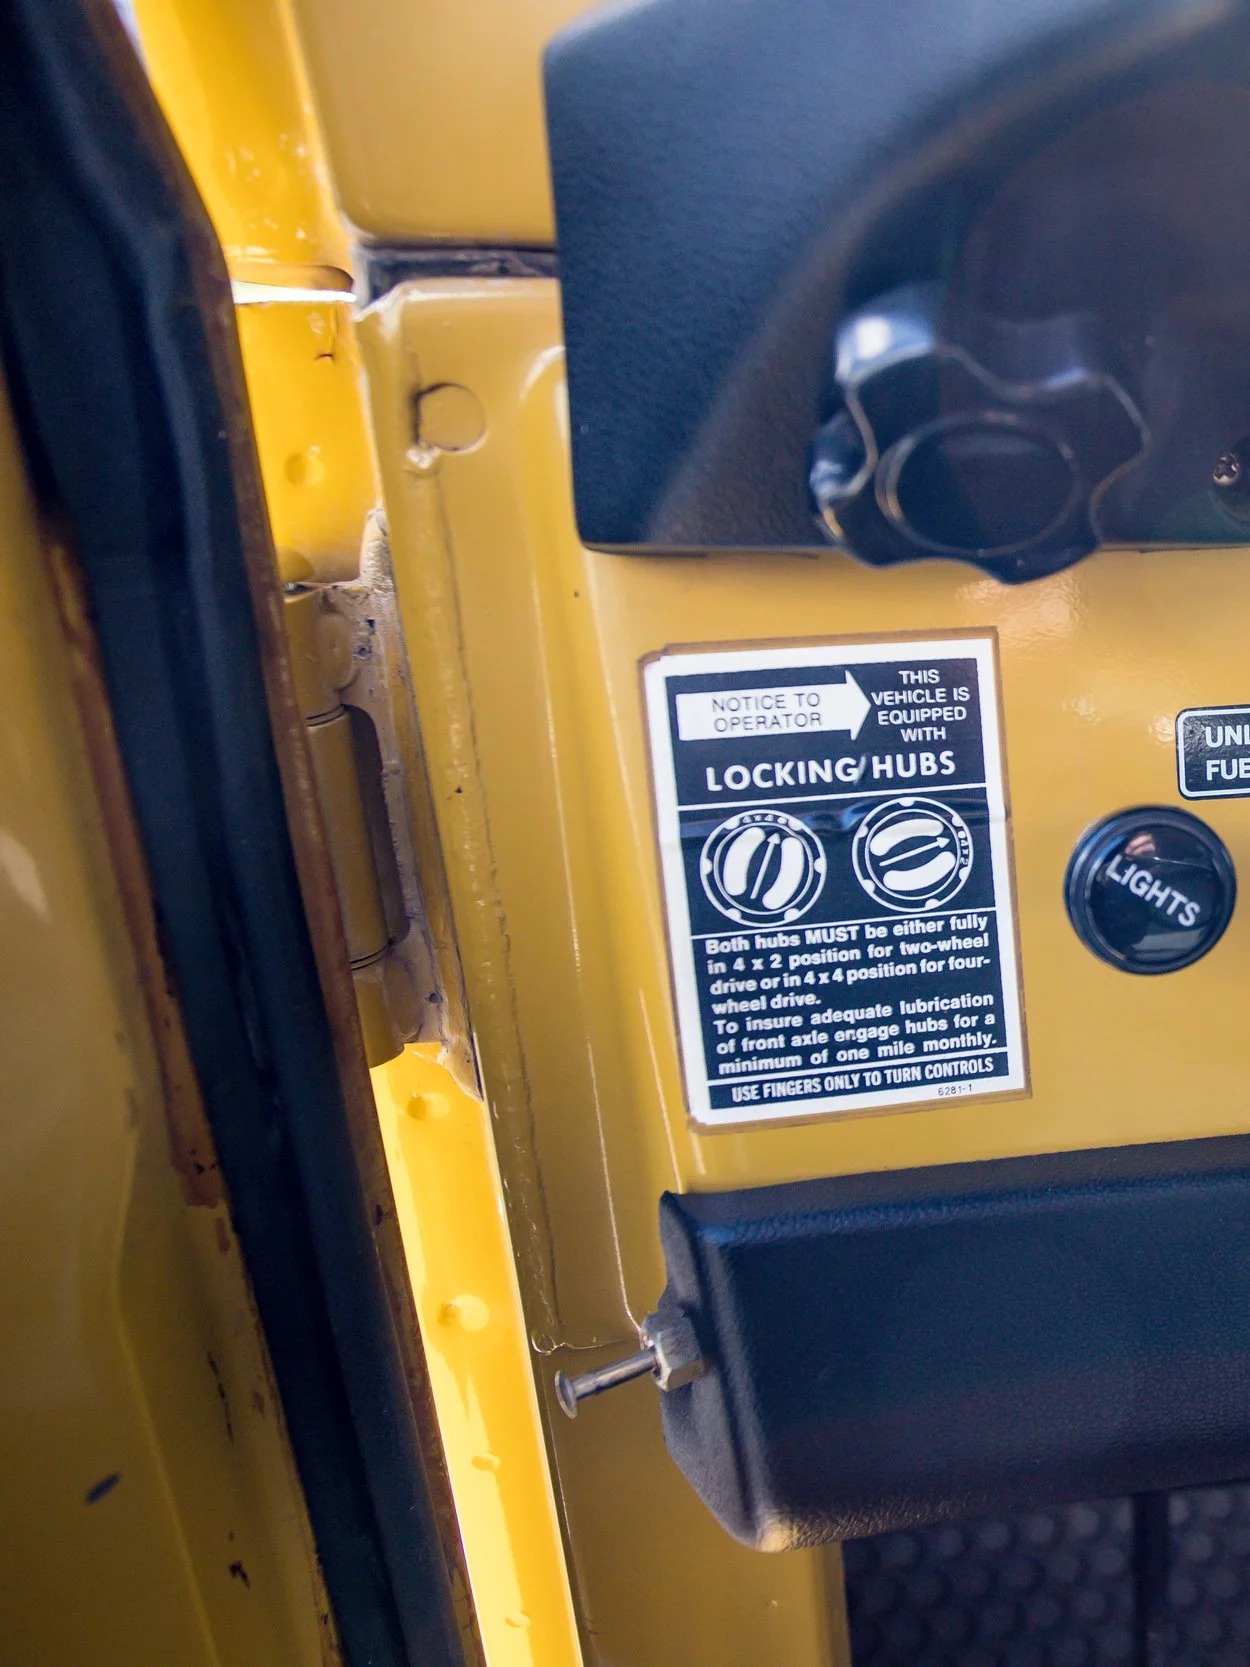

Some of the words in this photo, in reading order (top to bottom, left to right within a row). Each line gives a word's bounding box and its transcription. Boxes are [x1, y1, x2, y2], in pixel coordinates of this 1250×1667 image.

[871, 689, 947, 706] VEHICLE
[953, 687, 970, 702] IS
[899, 669, 940, 684] THIS
[712, 694, 786, 713] NOTICE
[797, 692, 821, 708] TO
[714, 712, 822, 733] OPERATOR
[878, 706, 967, 725] EQUIPPED
[901, 727, 946, 742] WITH
[706, 756, 857, 792] LOCKING
[872, 750, 956, 779] HUBS
[1106, 854, 1200, 927] LIGHTS
[705, 936, 750, 954] Both
[755, 933, 800, 949] hubs
[805, 926, 860, 945] MUST
[865, 924, 888, 939] be
[893, 919, 945, 936] either
[950, 914, 988, 931] fully
[707, 960, 726, 974] in
[733, 957, 746, 972] 4
[769, 953, 783, 969] 2
[788, 947, 861, 970] position
[867, 944, 893, 958] for
[899, 933, 989, 956] two-wheel
[709, 978, 757, 995] drive
[760, 977, 781, 990] or
[783, 973, 801, 988] in
[846, 962, 917, 985] position
[920, 958, 946, 973] for
[948, 955, 991, 971] four-
[711, 995, 767, 1015] wheel
[770, 992, 821, 1009] drive.
[713, 1019, 739, 1035] To
[745, 1015, 803, 1031] insure
[810, 1003, 893, 1025] adequate
[900, 993, 994, 1015] lubrication
[716, 1038, 736, 1055] of
[741, 1034, 786, 1052] front
[791, 1030, 829, 1047] axle
[834, 1024, 900, 1043] engage
[905, 1017, 948, 1034] hubs
[953, 1013, 979, 1029] for
[984, 1013, 995, 1026] a
[718, 1054, 802, 1075] minimum
[810, 1049, 829, 1065] of
[836, 1047, 870, 1062] one
[877, 1040, 915, 1058] mile
[923, 1031, 997, 1052] monthly.
[731, 1085, 761, 1103] USE
[763, 1077, 822, 1099] FINGERS
[824, 1073, 861, 1092] ONLY
[863, 1071, 882, 1087] TO
[884, 1066, 922, 1084] TURN
[925, 1056, 994, 1080] CONTROLS
